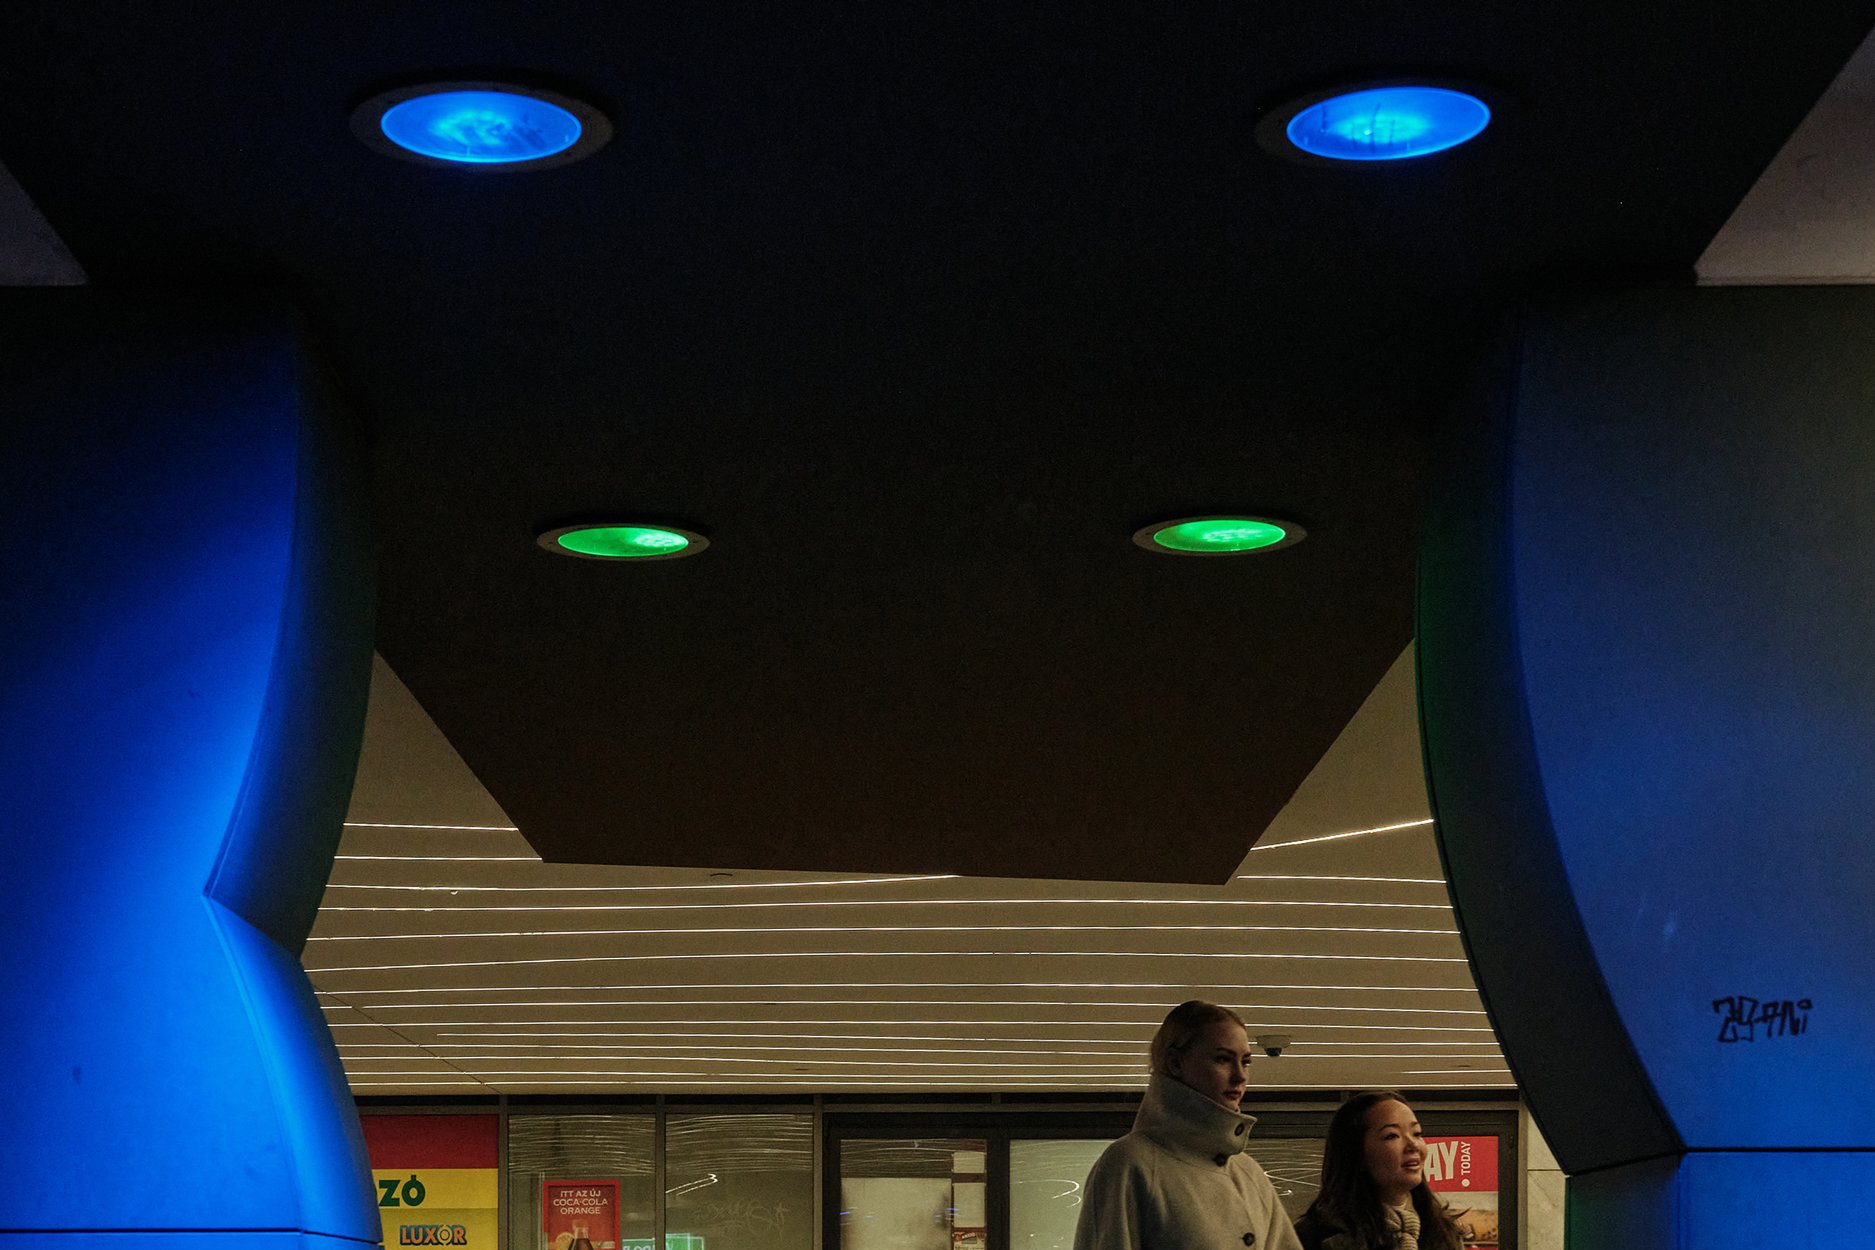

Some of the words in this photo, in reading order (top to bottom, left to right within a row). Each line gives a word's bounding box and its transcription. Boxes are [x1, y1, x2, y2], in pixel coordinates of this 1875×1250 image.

[1461, 1141, 1471, 1175] TODAY
[560, 1190, 574, 1198] ITT
[575, 1190, 588, 1198] AZ
[589, 1188, 601, 1197] ÚJ
[560, 1207, 601, 1215] ORANGE
[400, 1225, 467, 1245] LUXOR
